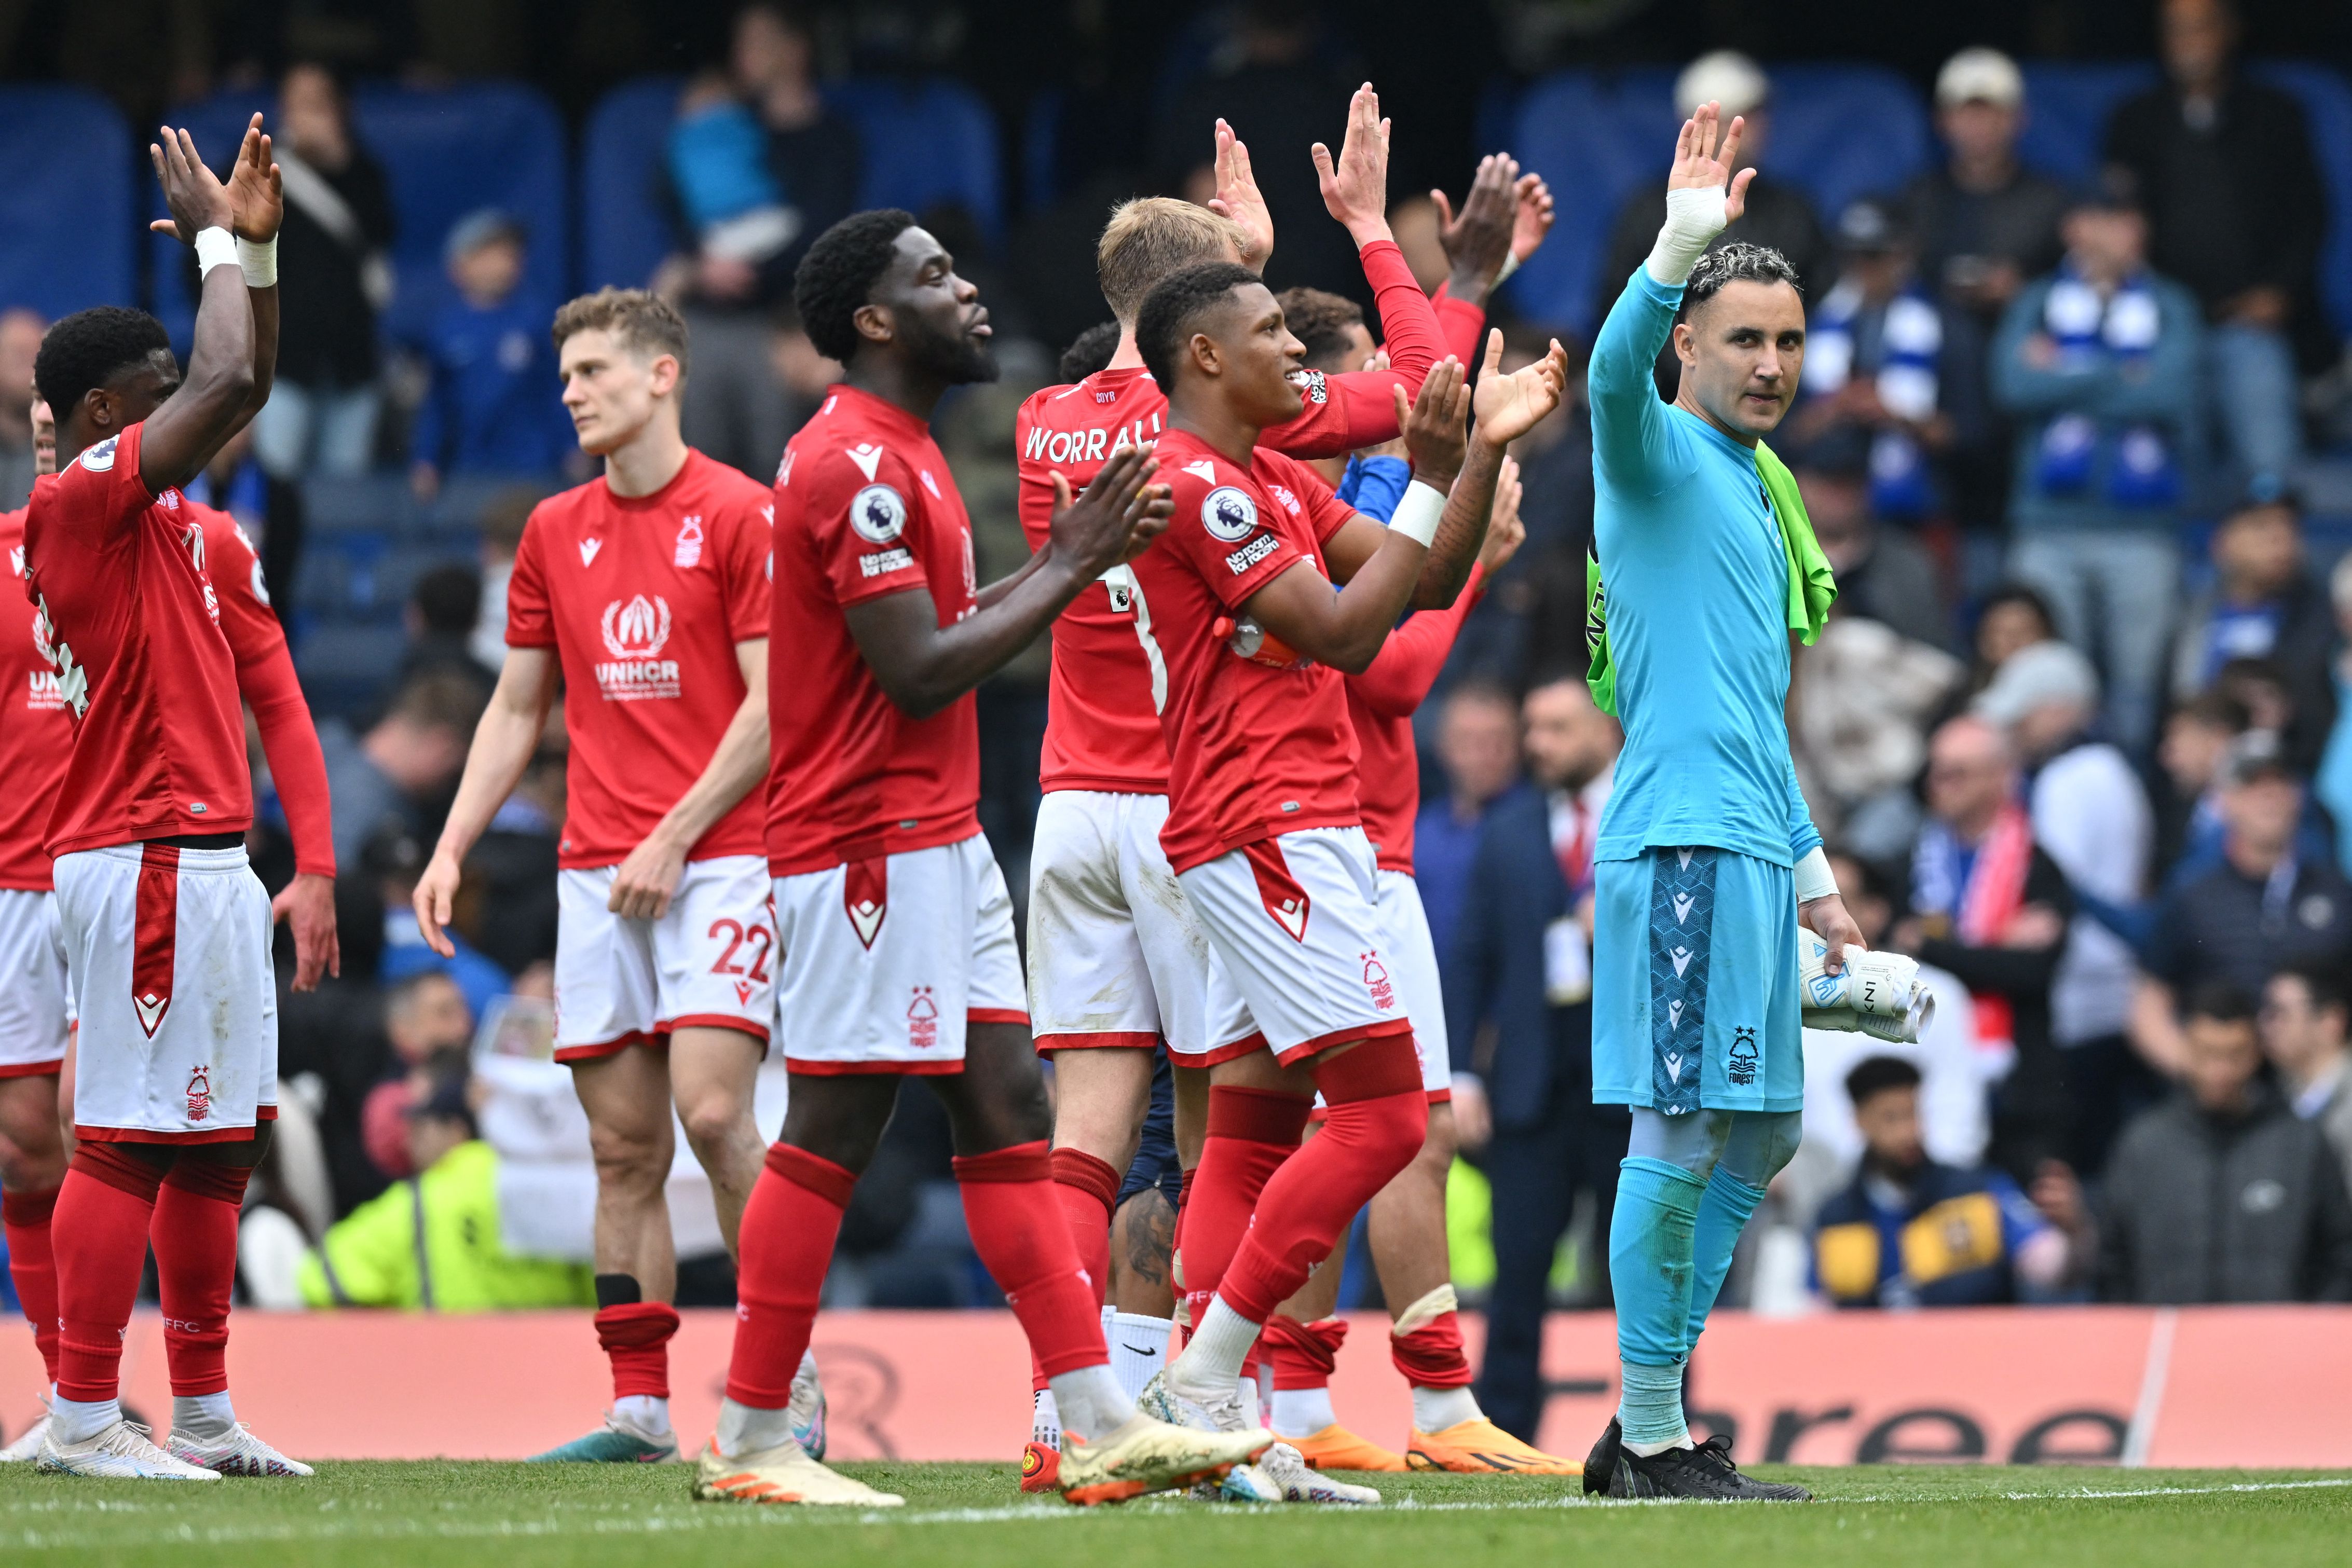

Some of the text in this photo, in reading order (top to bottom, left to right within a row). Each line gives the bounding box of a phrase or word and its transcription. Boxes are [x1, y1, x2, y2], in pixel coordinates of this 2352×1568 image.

[1096, 391, 1115, 403] COYR
[1226, 534, 1270, 564] No room
[1232, 559, 1248, 575] for
[595, 661, 679, 684] UNHCR
[708, 918, 771, 984] 22
[1864, 981, 1876, 1013] KN1
